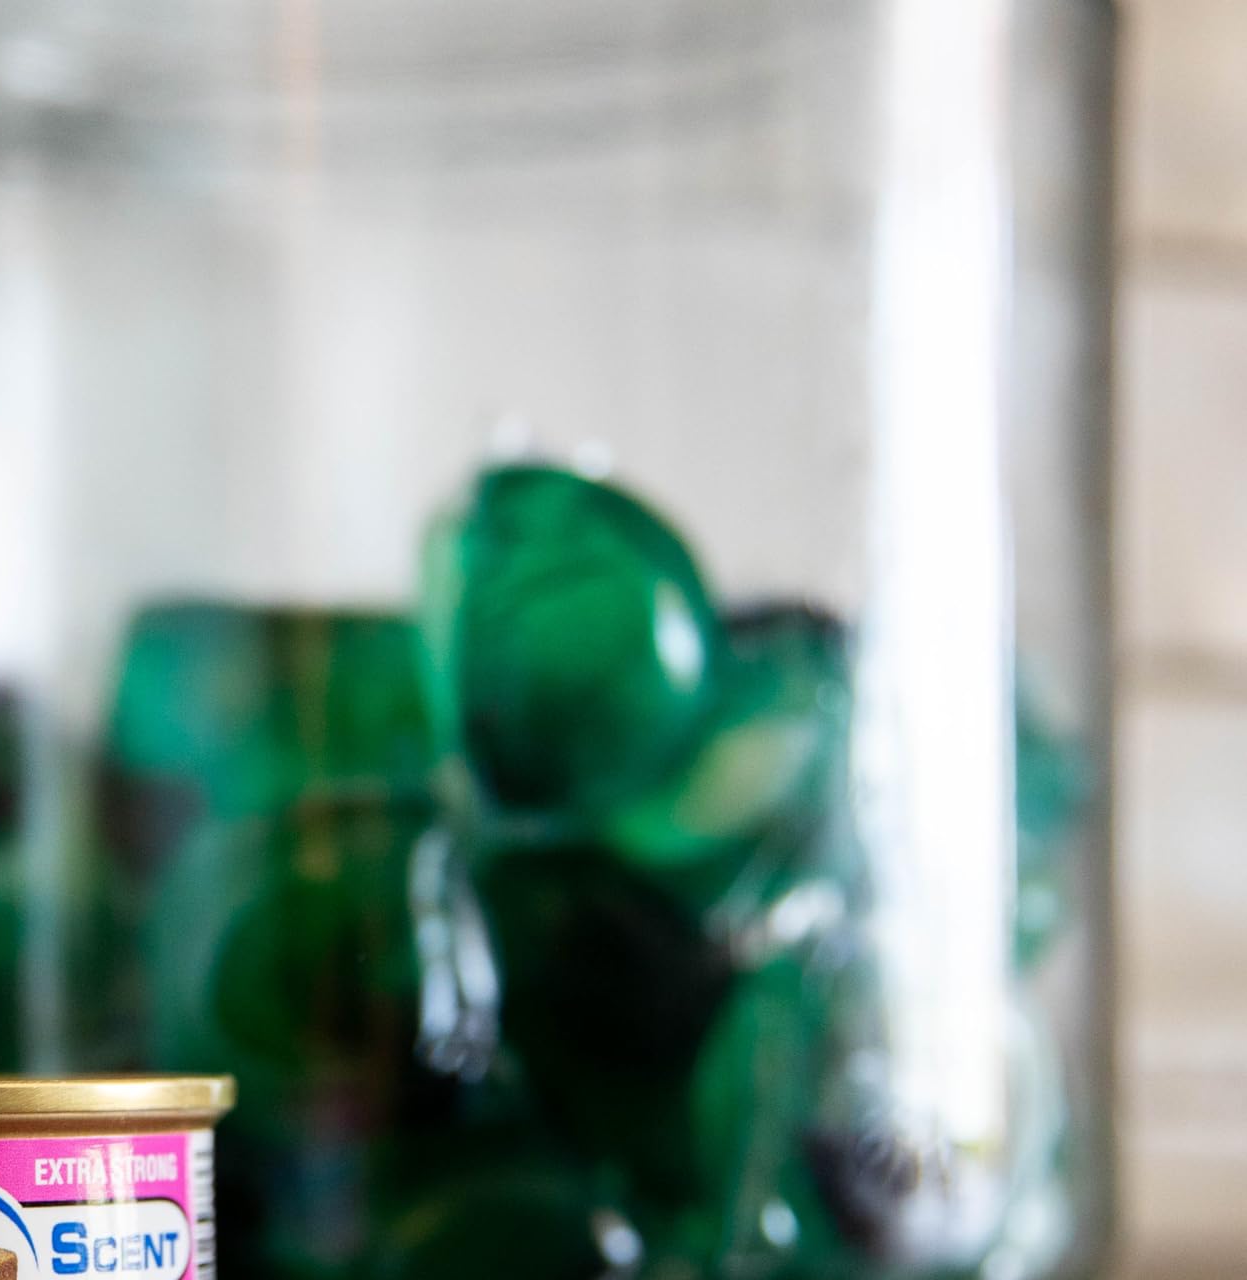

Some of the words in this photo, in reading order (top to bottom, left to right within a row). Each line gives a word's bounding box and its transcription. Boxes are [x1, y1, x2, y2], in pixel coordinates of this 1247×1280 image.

[35, 1156, 107, 1186] EXTRA
[111, 1154, 178, 1184] STRONG
[51, 1222, 179, 1275] SCENT
